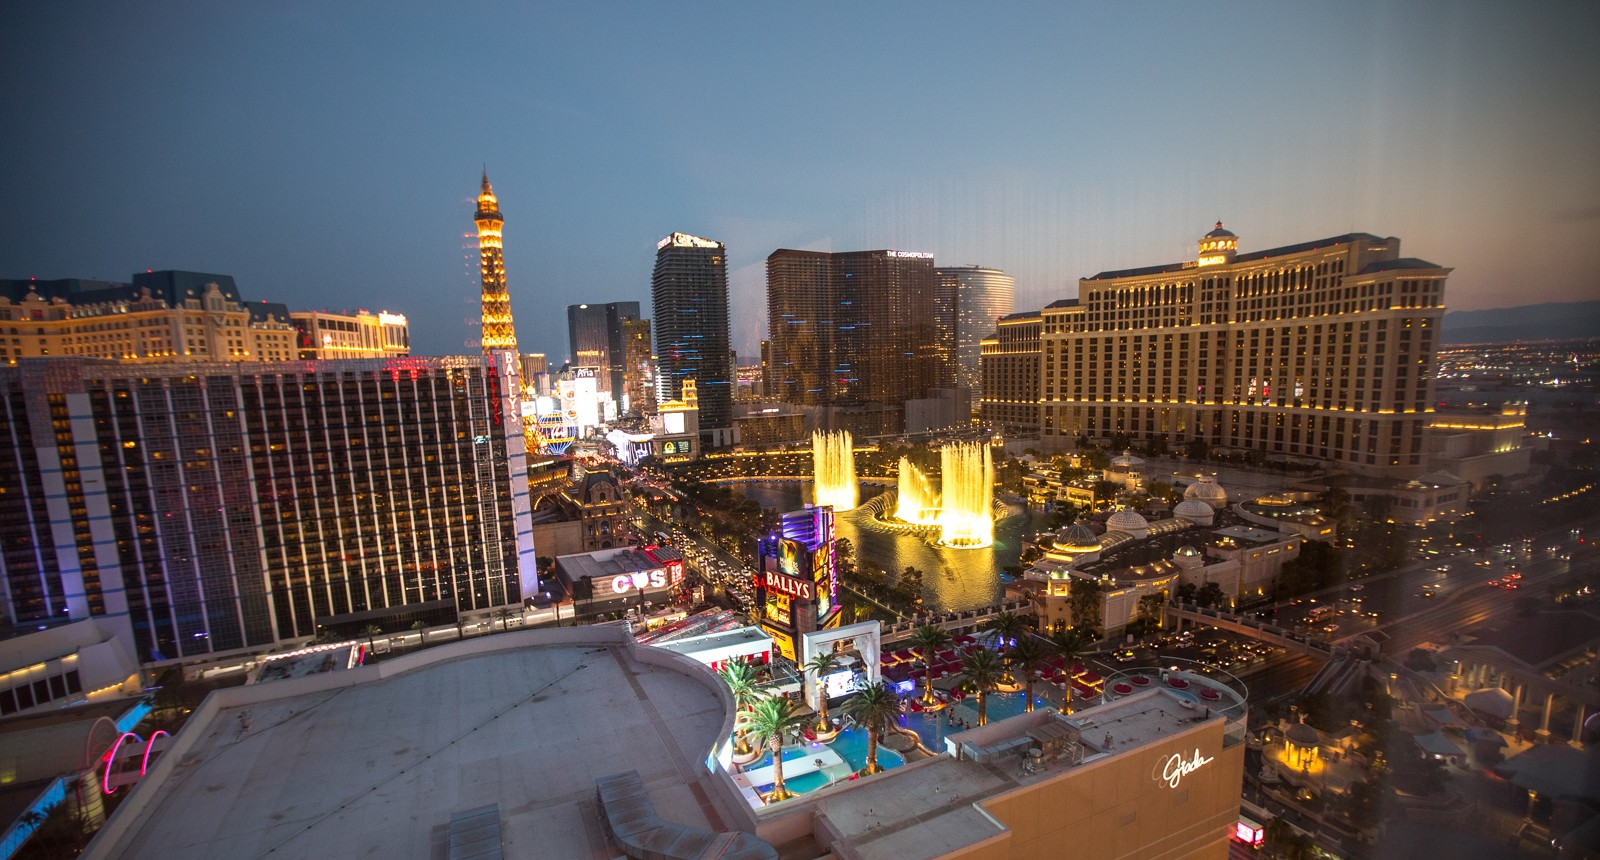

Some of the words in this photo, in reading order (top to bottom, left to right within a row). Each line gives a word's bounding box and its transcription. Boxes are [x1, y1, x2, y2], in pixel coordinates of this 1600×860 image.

[897, 251, 934, 259] COSMOPOLITAN
[504, 352, 517, 422] BALLYS
[766, 571, 810, 599] BALLYS
